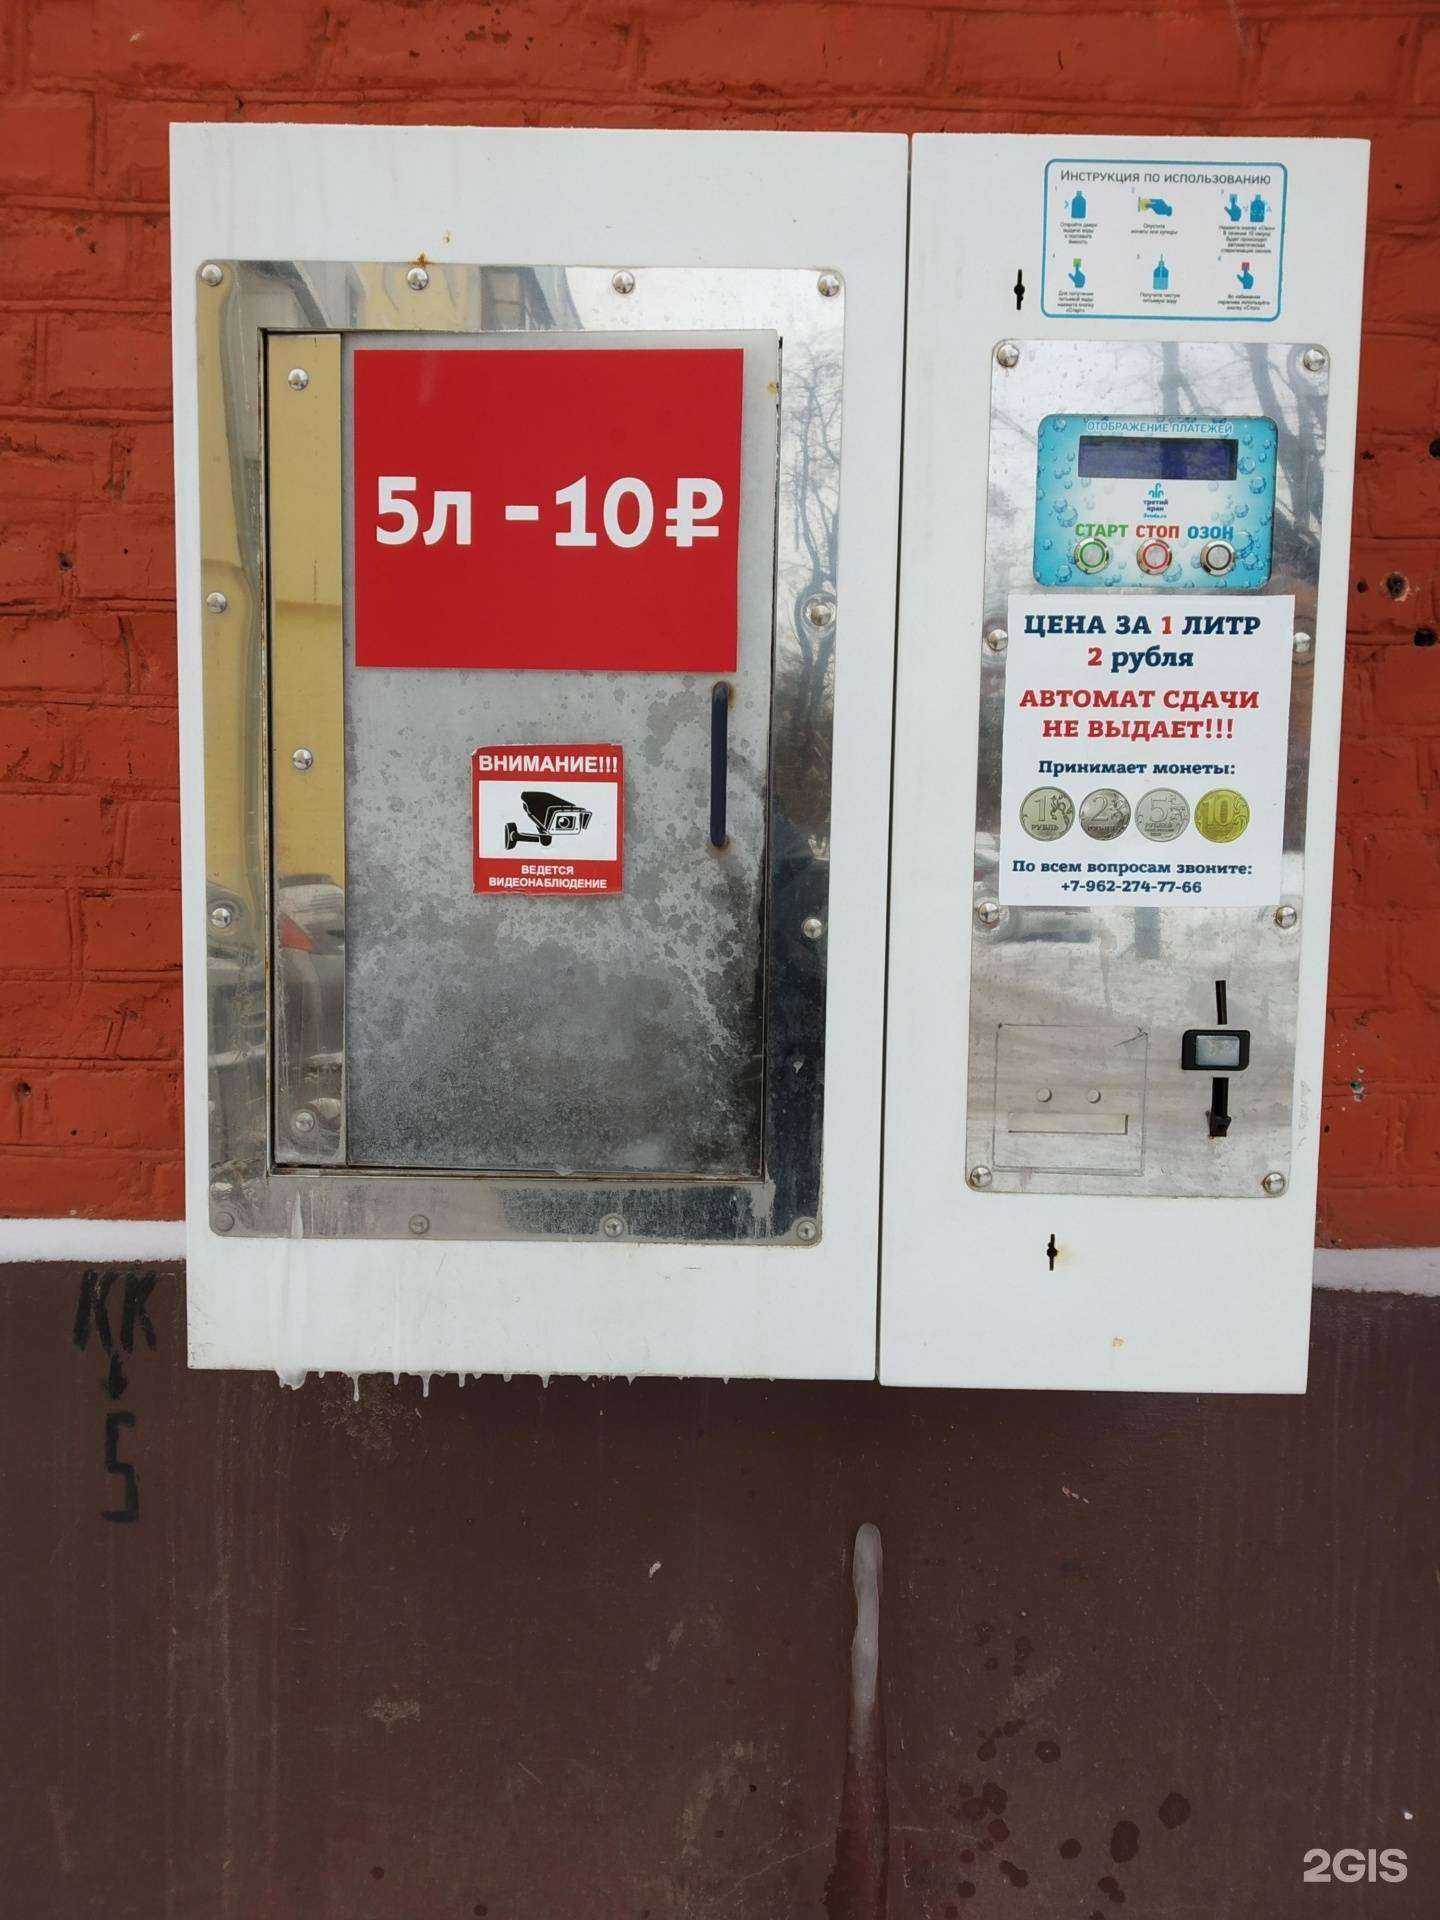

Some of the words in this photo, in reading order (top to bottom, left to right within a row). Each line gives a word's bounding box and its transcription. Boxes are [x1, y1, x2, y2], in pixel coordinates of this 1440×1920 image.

[1087, 421, 1168, 433] ОТОБРАЖЕНИЕ
[1172, 421, 1233, 434] ПЛАТЕЖЕЙ
[1075, 523, 1129, 538] СТАРТ
[1135, 524, 1180, 539] СТОП
[1187, 525, 1234, 541] ОЗОН
[1024, 614, 1106, 638] ЦЕНА
[1115, 614, 1152, 636] ЗА
[1161, 615, 1173, 635] 1
[1181, 615, 1261, 636] ЛИТР
[1087, 646, 1103, 667] 2
[1110, 645, 1194, 674] рубля
[1019, 689, 1155, 709] АВТОМАТ
[1163, 689, 1260, 712] СДАЧИ
[1042, 719, 1079, 738] НЕ
[1087, 718, 1233, 742] ВЫДАЕТ!!!
[478, 755, 618, 774] ВНИМАНИЕ!!!
[1038, 760, 1147, 778] Принимает
[1153, 762, 1236, 775] монеты:
[521, 865, 574, 876] ВЕДЕТСЯ
[1012, 859, 1035, 873] По
[1041, 862, 1082, 873] всем
[1087, 863, 1171, 877] вопросам
[1176, 864, 1253, 876] звоните:
[488, 877, 607, 889] ВИДЕОНАБЛЮДЕНИЕ
[1061, 879, 1202, 894] +7-962-274-77-66
